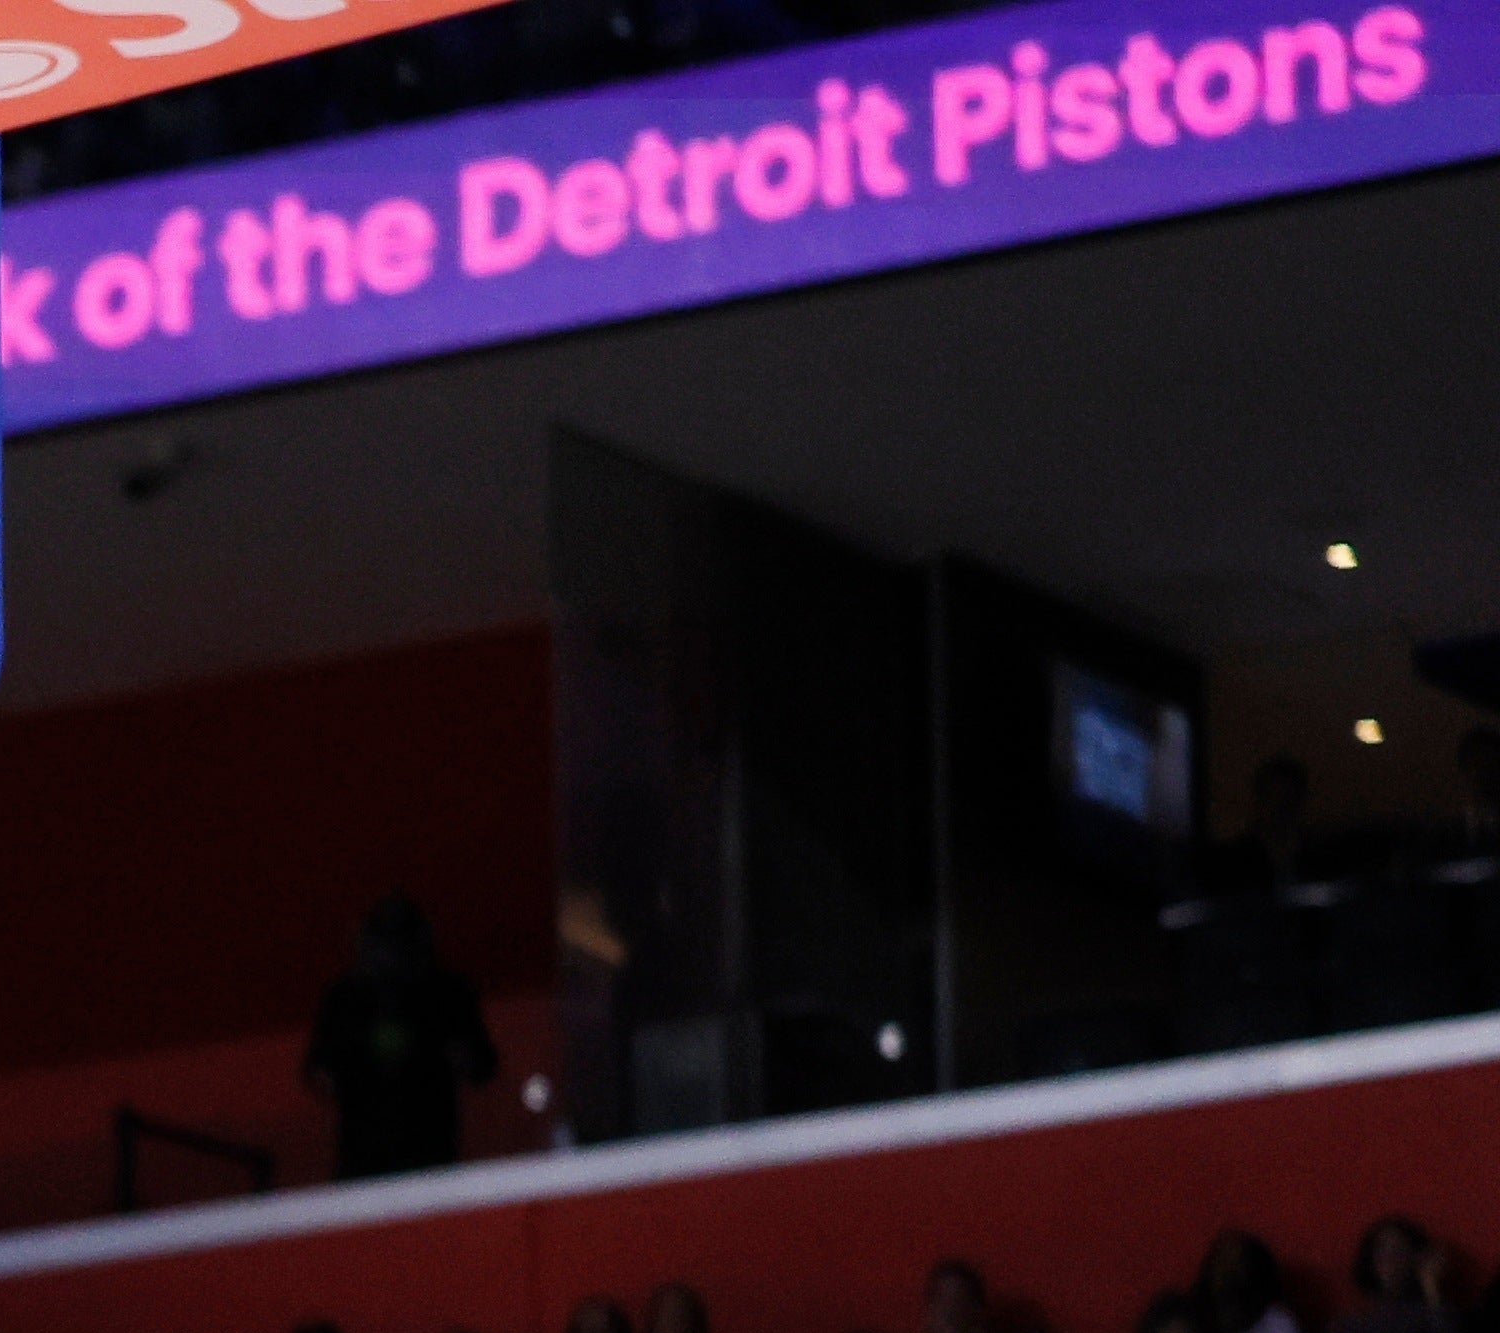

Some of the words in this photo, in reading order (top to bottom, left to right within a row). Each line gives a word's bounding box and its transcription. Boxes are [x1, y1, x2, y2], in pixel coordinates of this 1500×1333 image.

[72, 208, 203, 349] of
[218, 194, 438, 320] the
[459, 80, 908, 278] Detroit
[932, 7, 1427, 185] Pistons
